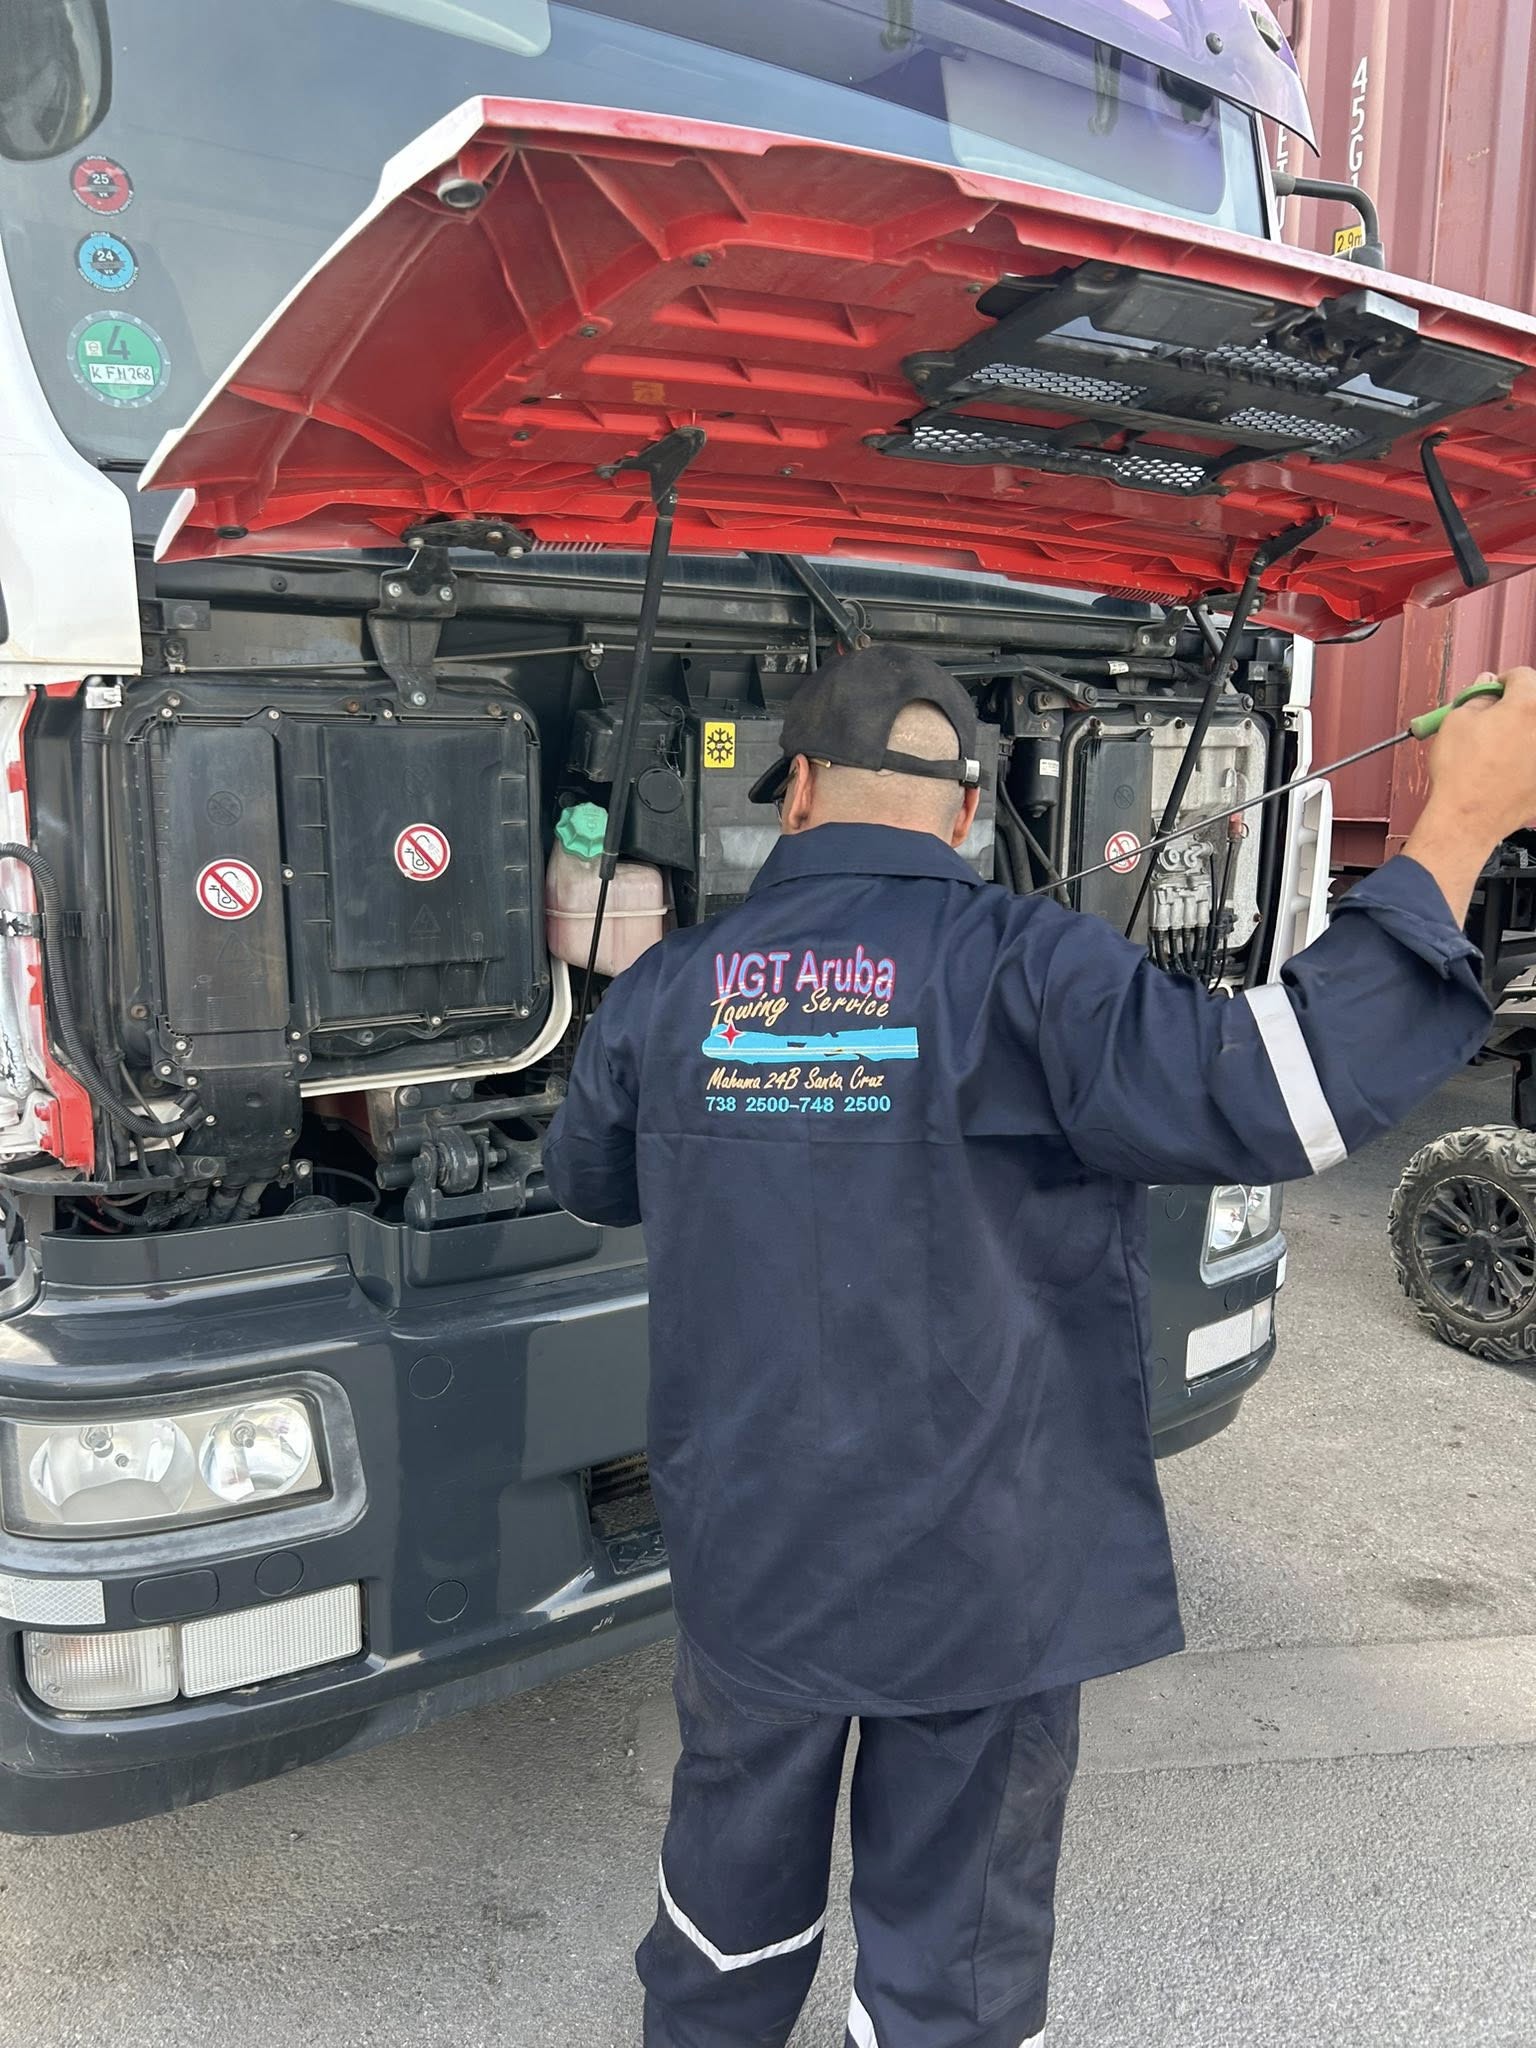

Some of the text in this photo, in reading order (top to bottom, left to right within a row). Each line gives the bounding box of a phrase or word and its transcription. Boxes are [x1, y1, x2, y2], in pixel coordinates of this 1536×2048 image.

[92, 173, 109, 185] 25
[97, 250, 114, 262] 24
[107, 325, 131, 361] 4
[714, 944, 896, 1004] VGT Aruba
[710, 986, 890, 1028] Towing Service
[706, 1065, 885, 1092] Mahuma 24B Santa Cruz
[705, 1096, 737, 1112] 738
[843, 1095, 892, 1112] 2500
